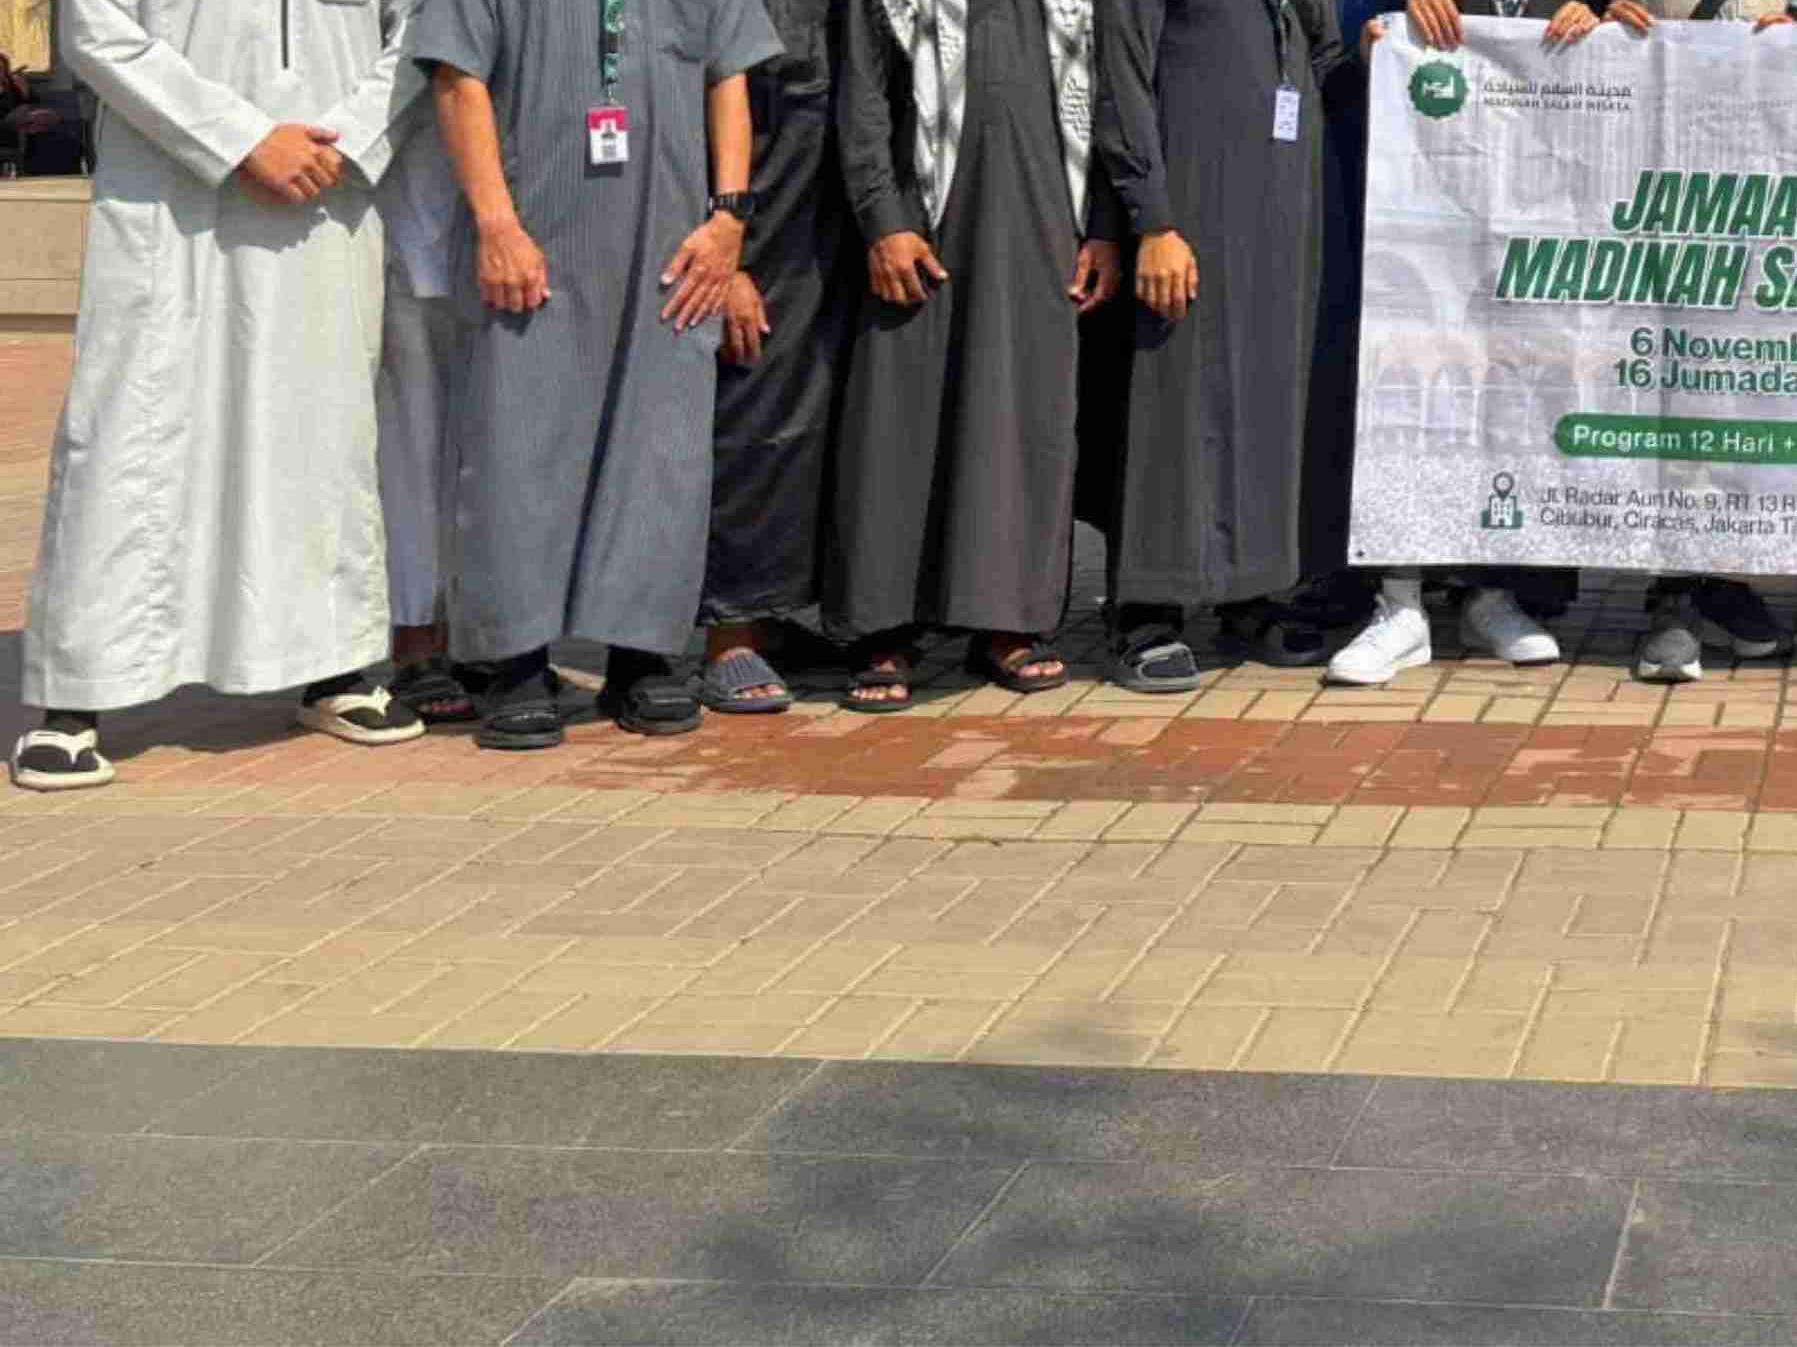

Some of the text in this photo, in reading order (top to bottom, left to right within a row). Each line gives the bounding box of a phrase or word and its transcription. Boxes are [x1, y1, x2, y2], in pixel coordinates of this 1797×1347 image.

[1497, 237, 1746, 307] MADINAH
[1630, 327, 1653, 357] 6
[1614, 358, 1652, 388] 16
[1573, 424, 1682, 453] Program
[1689, 432, 1713, 452] 12
[1721, 431, 1775, 454] Hari
[1784, 438, 1796, 450] +
[1565, 486, 1622, 506] Radar
[1727, 493, 1750, 511] RT
[1757, 494, 1778, 512] 13
[1541, 507, 1618, 530] Cibubur,
[1624, 510, 1699, 534] Ciracas,
[1704, 514, 1775, 535] Jakarta
